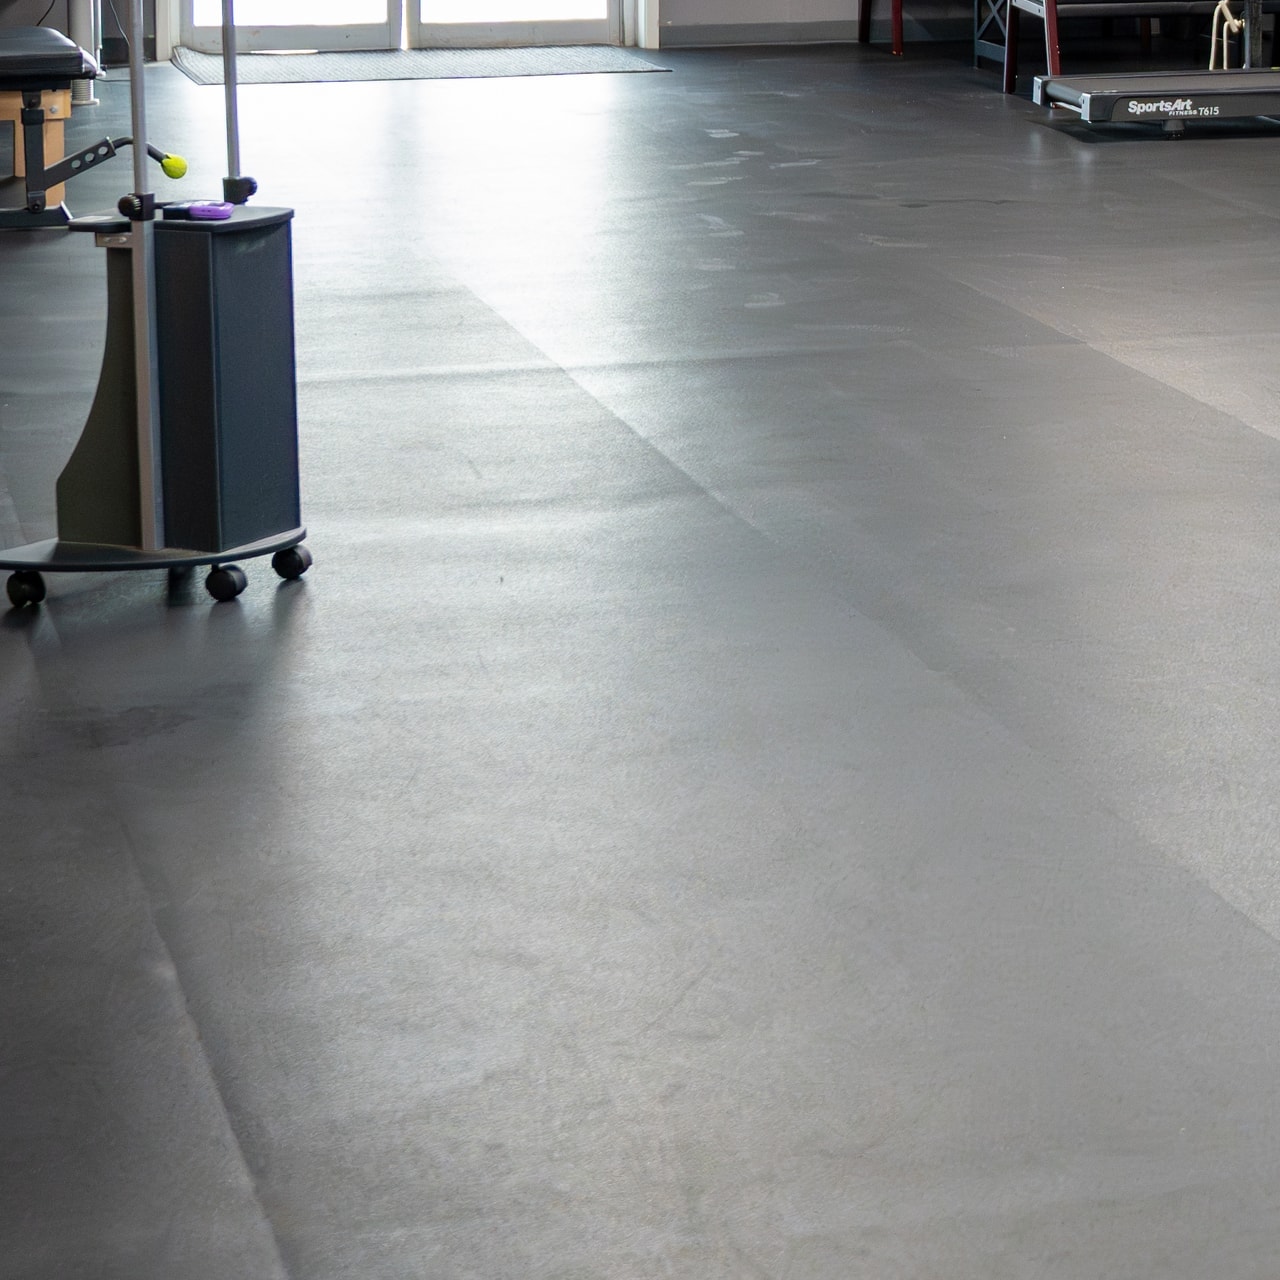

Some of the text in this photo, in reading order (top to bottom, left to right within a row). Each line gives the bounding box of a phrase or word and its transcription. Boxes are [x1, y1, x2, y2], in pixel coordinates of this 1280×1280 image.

[1127, 98, 1193, 115] SportsArt
[1198, 106, 1220, 116] T615
[1168, 109, 1198, 117] FITNESS
